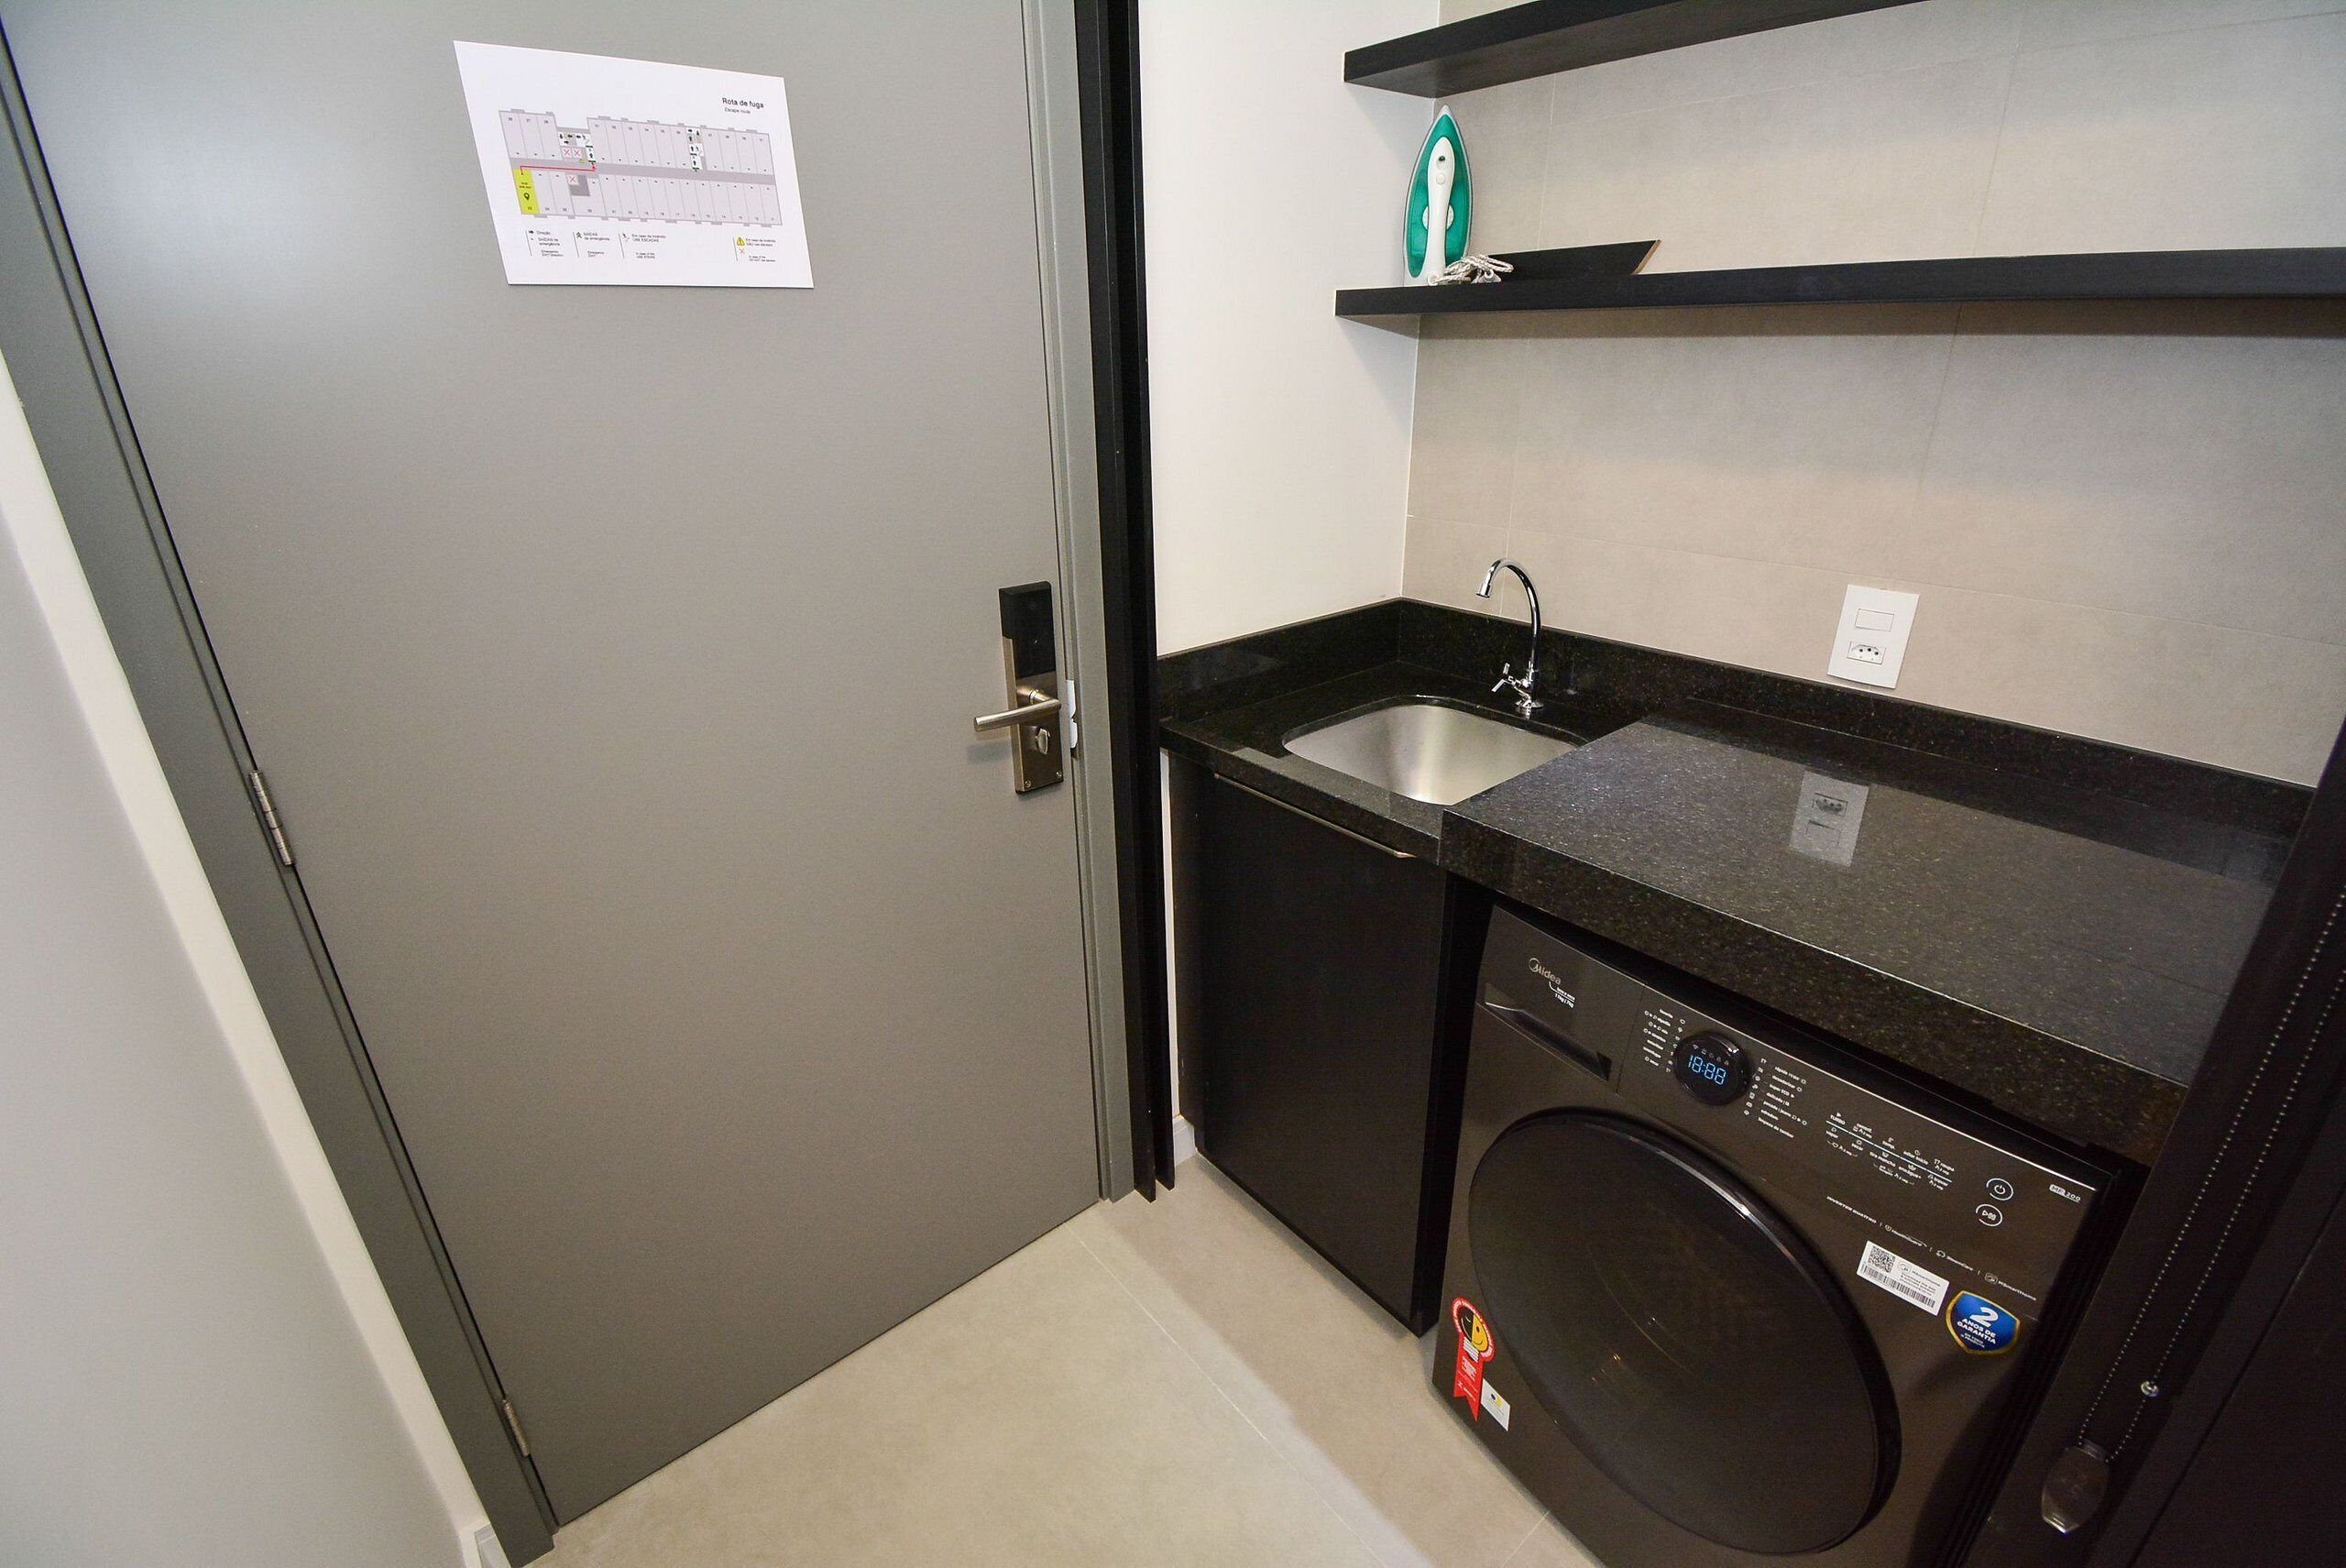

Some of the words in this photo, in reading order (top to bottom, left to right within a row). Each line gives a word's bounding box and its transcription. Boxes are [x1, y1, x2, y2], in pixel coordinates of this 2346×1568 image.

[722, 97, 738, 105] Rota
[750, 101, 763, 109] fuga
[1529, 957, 1562, 985] Midea
[1688, 1054, 1727, 1085] 18:88
[1831, 1114, 1846, 1125] TURBO
[1826, 1196, 1853, 1212] INVERTER
[1852, 1209, 1877, 1223] QUATTRO
[1962, 1318, 1984, 1332] ANOS
[1985, 1329, 1997, 1338] DE
[1969, 1307, 1999, 1328] 2
[1957, 1321, 1996, 1344] GARANTIA
